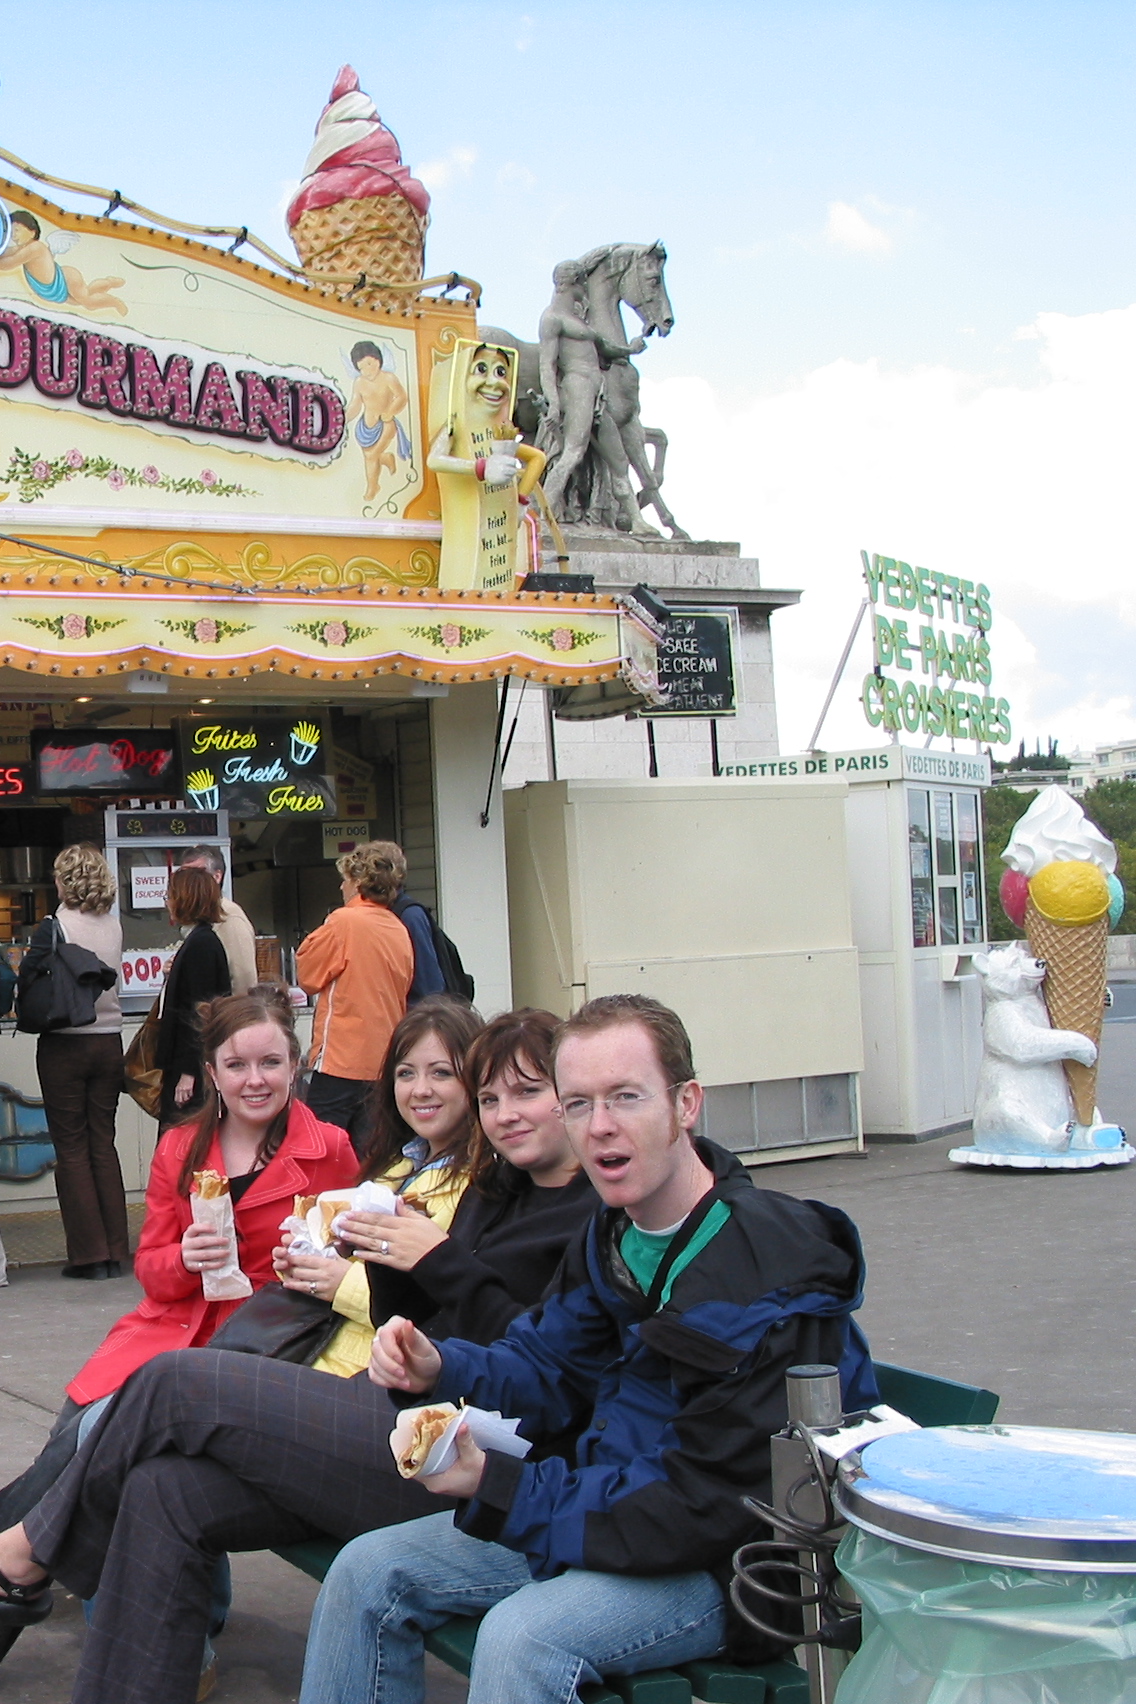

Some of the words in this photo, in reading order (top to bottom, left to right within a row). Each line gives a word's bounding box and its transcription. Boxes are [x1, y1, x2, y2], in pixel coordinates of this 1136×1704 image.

[860, 549, 993, 631] VEDETTES
[876, 614, 912, 670] DE
[920, 626, 993, 686] PARIS
[656, 657, 672, 673] CE
[863, 673, 1012, 745] CROISIERES
[190, 725, 259, 756] Frites
[39, 744, 102, 774] Hot
[108, 737, 173, 776] Dog
[222, 755, 289, 785] Fresh
[717, 761, 798, 776] VEDETTES
[804, 758, 828, 775] DE
[834, 754, 889, 772] PARIS
[905, 755, 947, 776] VEDETTES
[948, 760, 960, 778] DE
[961, 762, 986, 781] PARIS
[265, 786, 325, 815] Fries
[324, 826, 343, 837] HOT
[346, 826, 368, 837] DOG
[135, 876, 166, 886] SWEET
